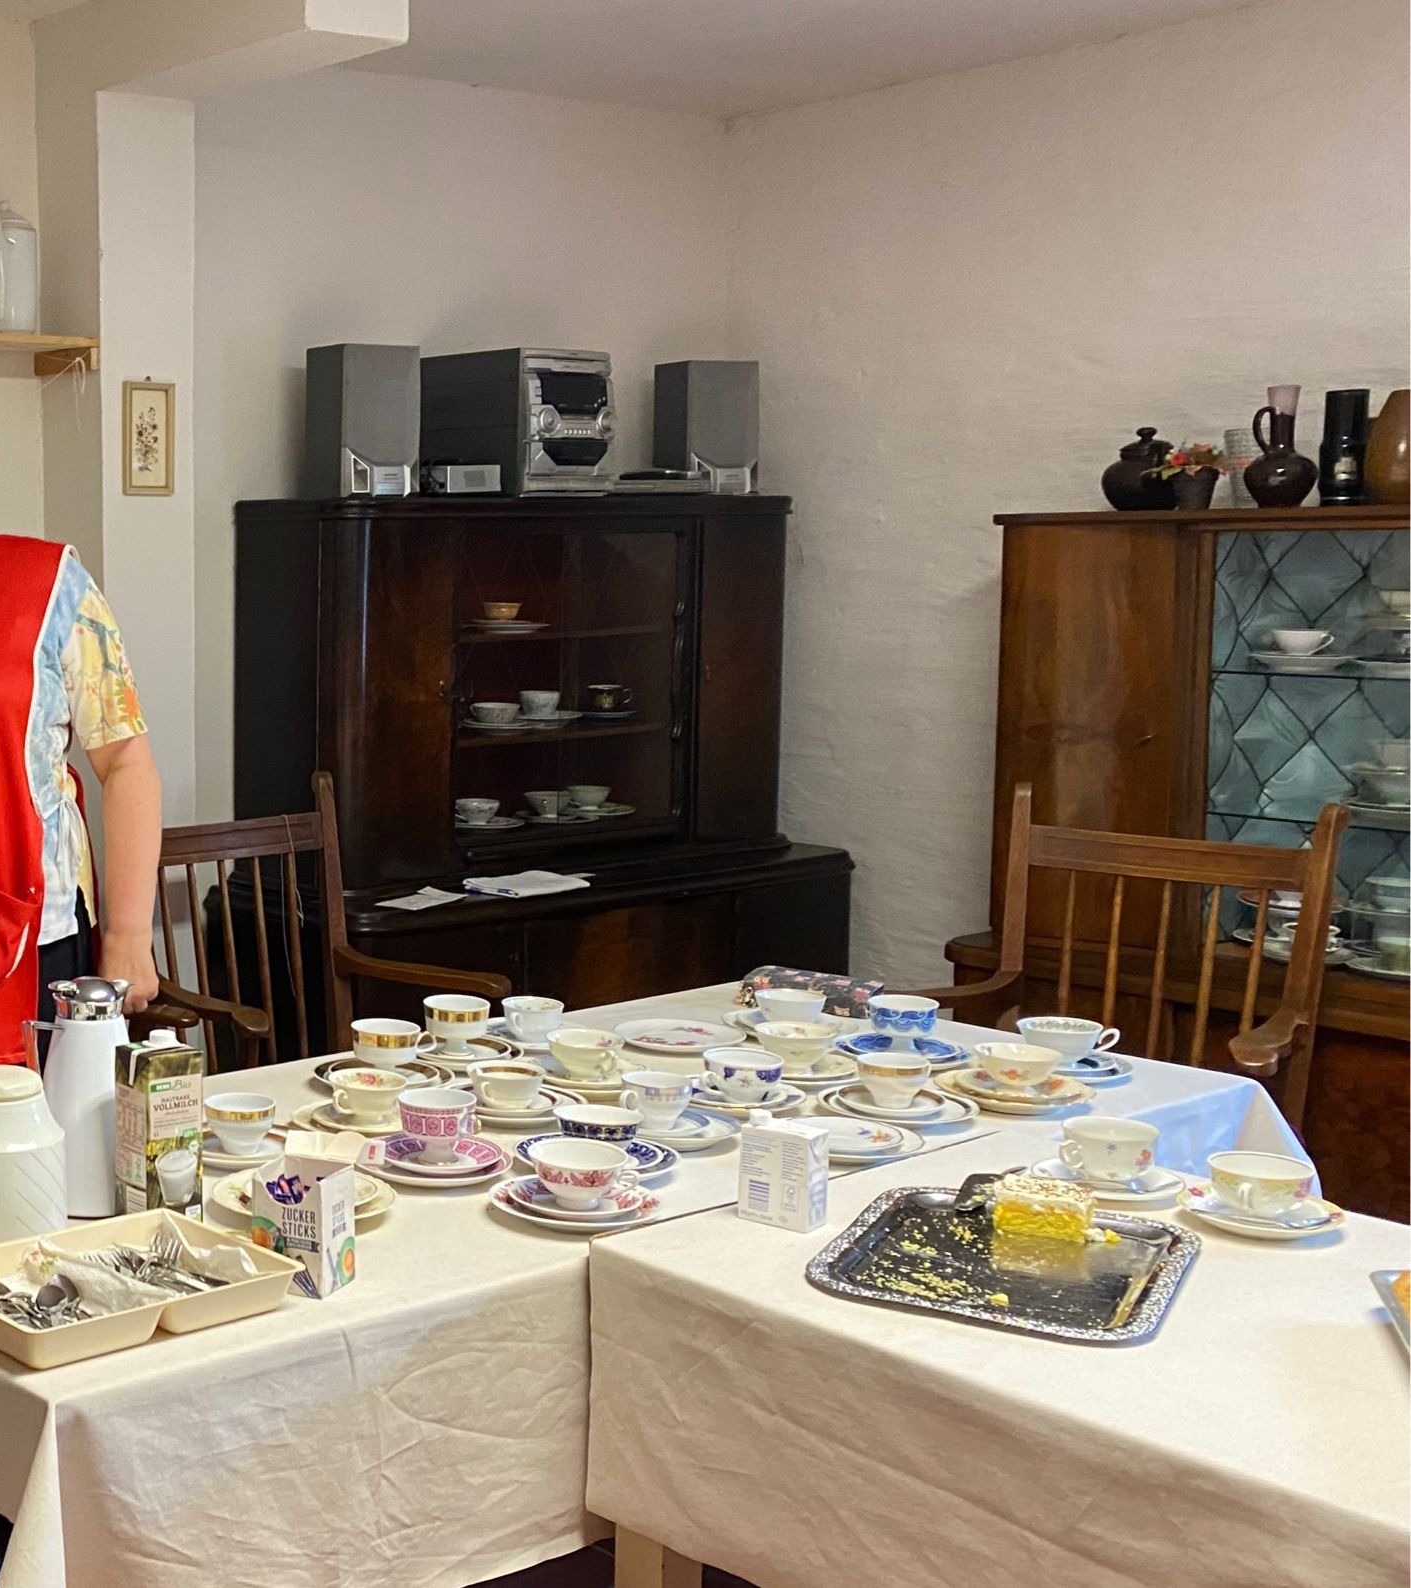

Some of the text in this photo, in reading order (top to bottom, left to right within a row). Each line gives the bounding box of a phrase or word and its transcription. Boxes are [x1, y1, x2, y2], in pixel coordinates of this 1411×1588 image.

[171, 1079, 192, 1091] Bio
[153, 1099, 199, 1112] VOLLMILCH
[281, 1206, 316, 1225] ZUCKER
[281, 1221, 317, 1239] STICKS
